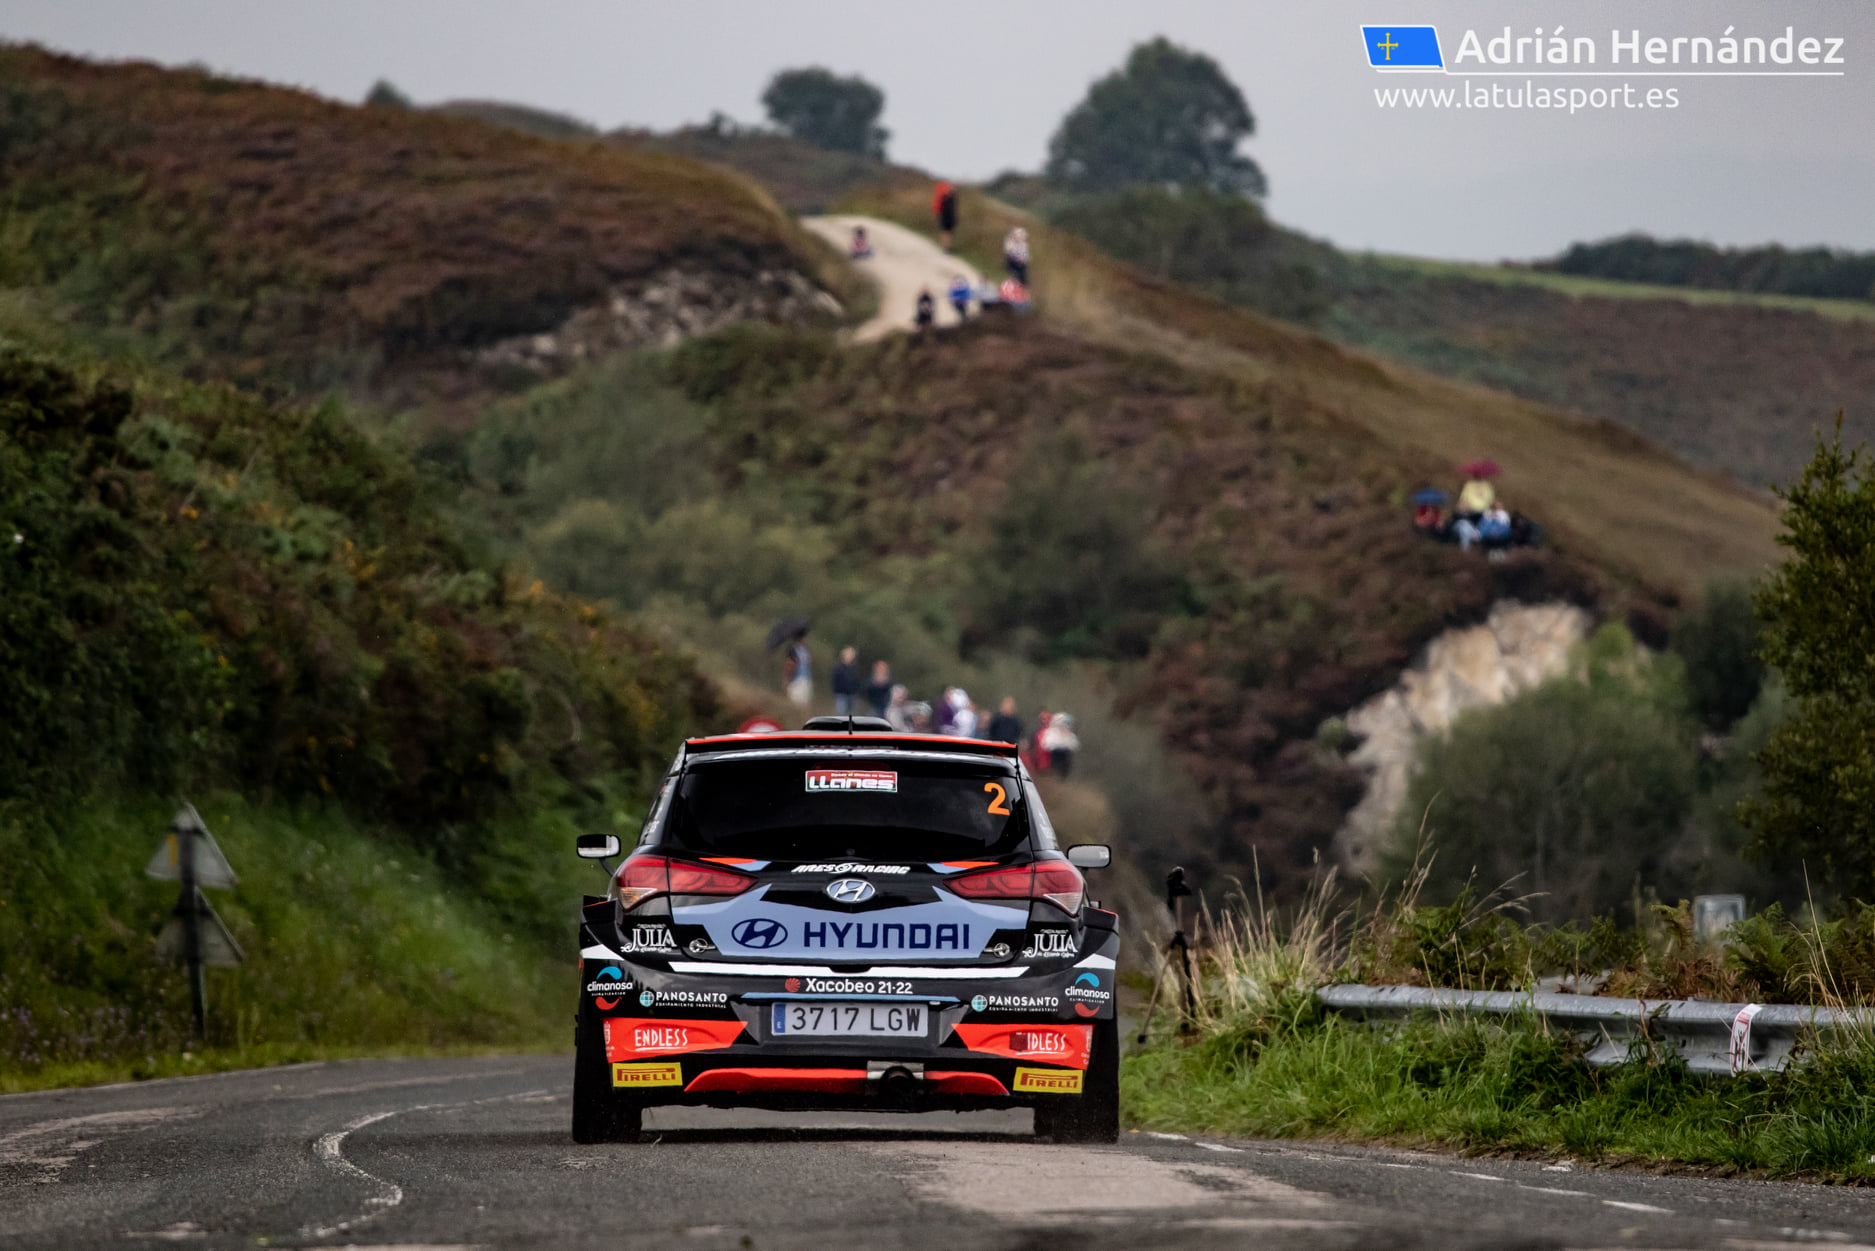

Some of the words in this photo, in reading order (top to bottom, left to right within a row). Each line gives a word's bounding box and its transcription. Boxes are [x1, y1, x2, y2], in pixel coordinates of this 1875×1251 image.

[984, 782, 1011, 816] 2
[791, 864, 837, 874] ARES
[850, 864, 912, 875] RACING
[620, 928, 678, 952] JULIA
[803, 921, 970, 950] HYUNDAI
[1022, 933, 1079, 957] JULIA
[586, 981, 633, 992] climanosa
[805, 977, 875, 993] Xacobeo
[1064, 986, 1110, 1000] climanosa
[656, 991, 728, 1003] PANOSANTO
[988, 995, 1059, 1007] PANOSANTO
[791, 1007, 860, 1031] 3717
[869, 1008, 921, 1032] LGW
[634, 1028, 688, 1047] ENDLESS
[616, 1067, 676, 1082] PIRELLI
[1019, 1072, 1079, 1089] PIRELLI
